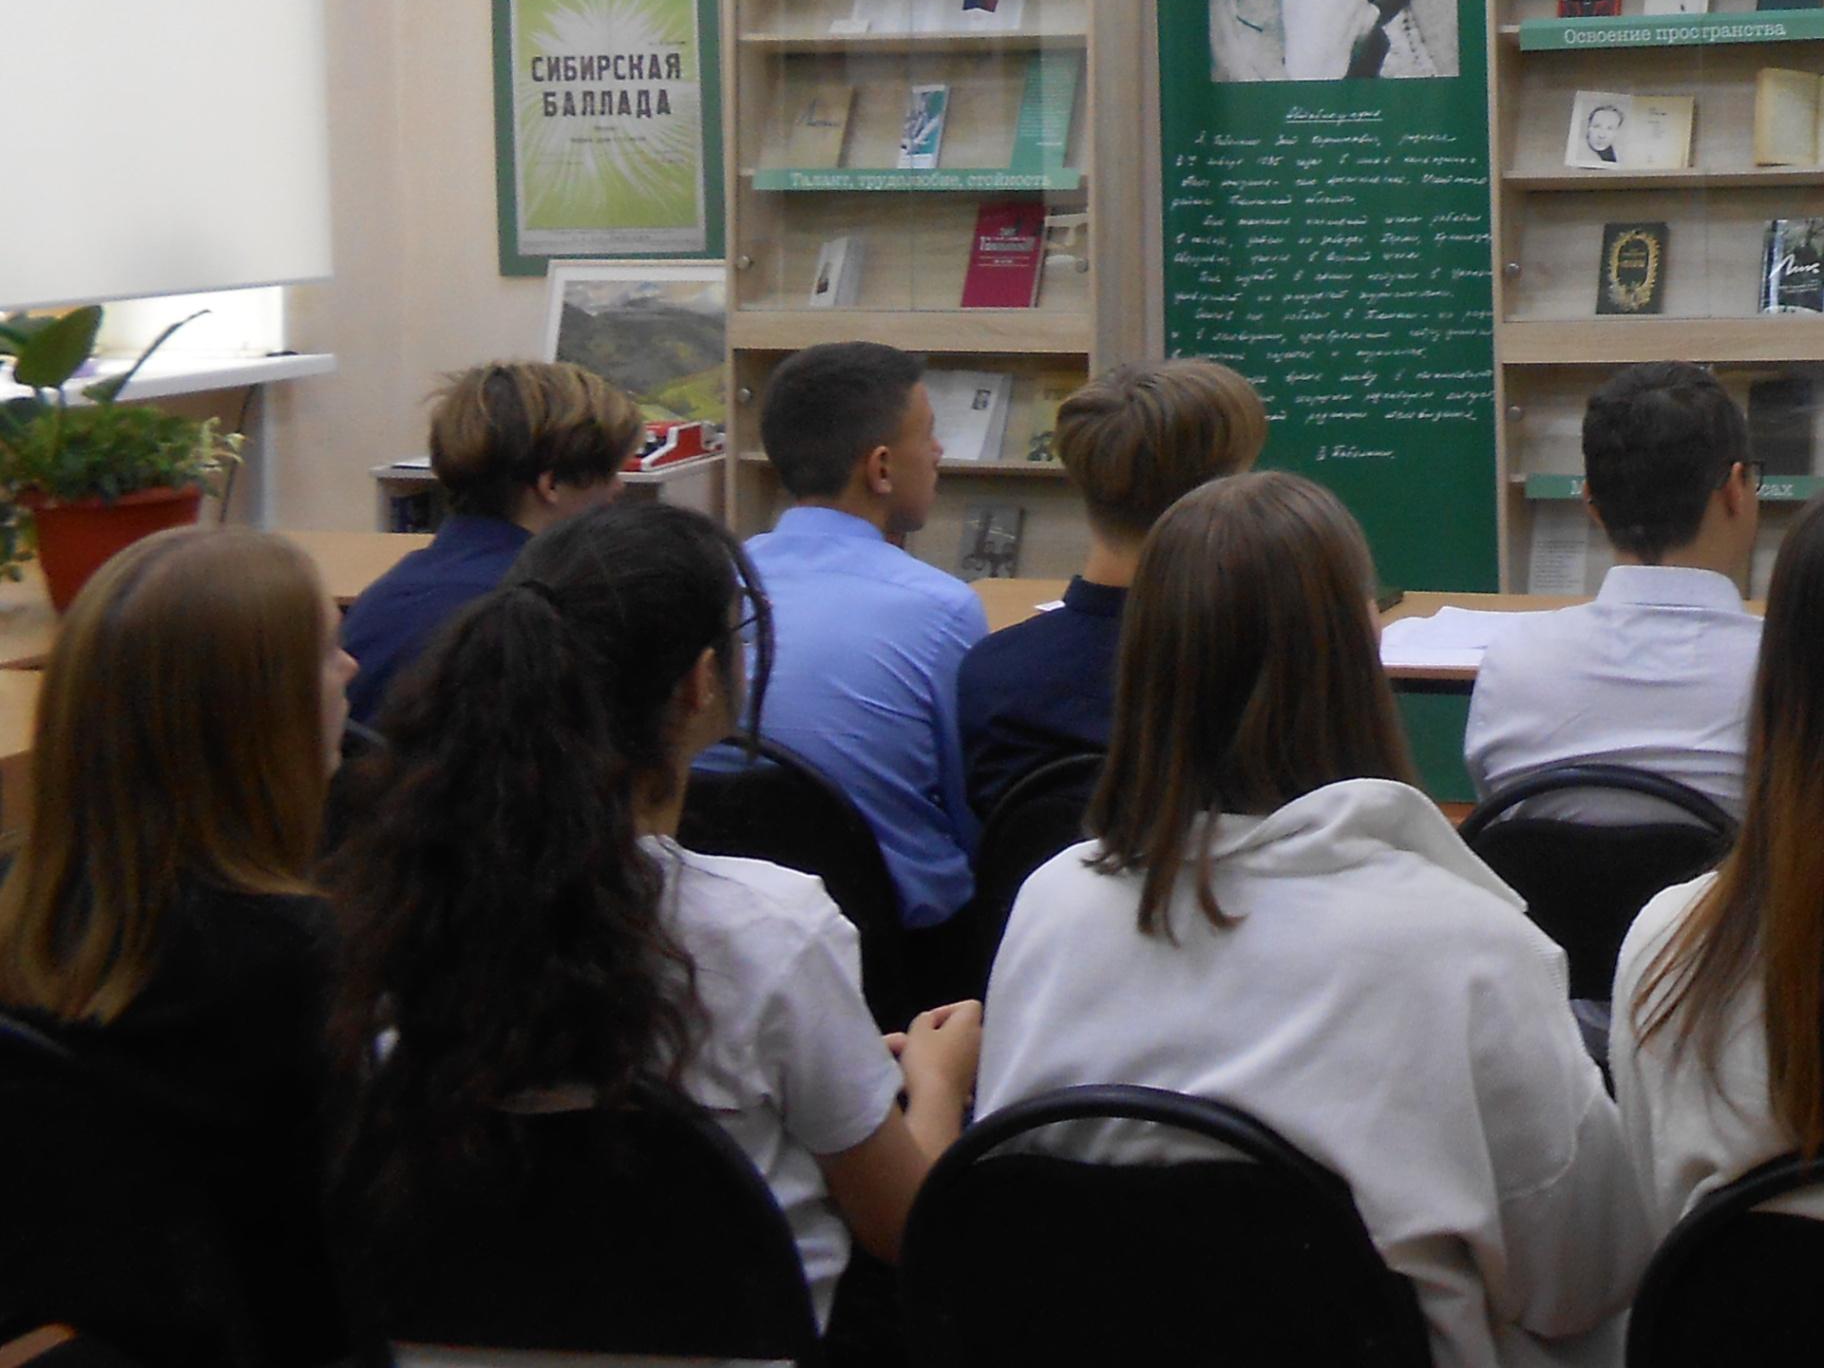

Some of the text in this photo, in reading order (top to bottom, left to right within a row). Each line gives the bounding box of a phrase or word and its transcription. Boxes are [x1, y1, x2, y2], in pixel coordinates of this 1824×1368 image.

[1564, 22, 1786, 44] Освоение пространства
[531, 52, 682, 83] СИБИРСКАЯ
[542, 89, 672, 118] БАЛЛАДА
